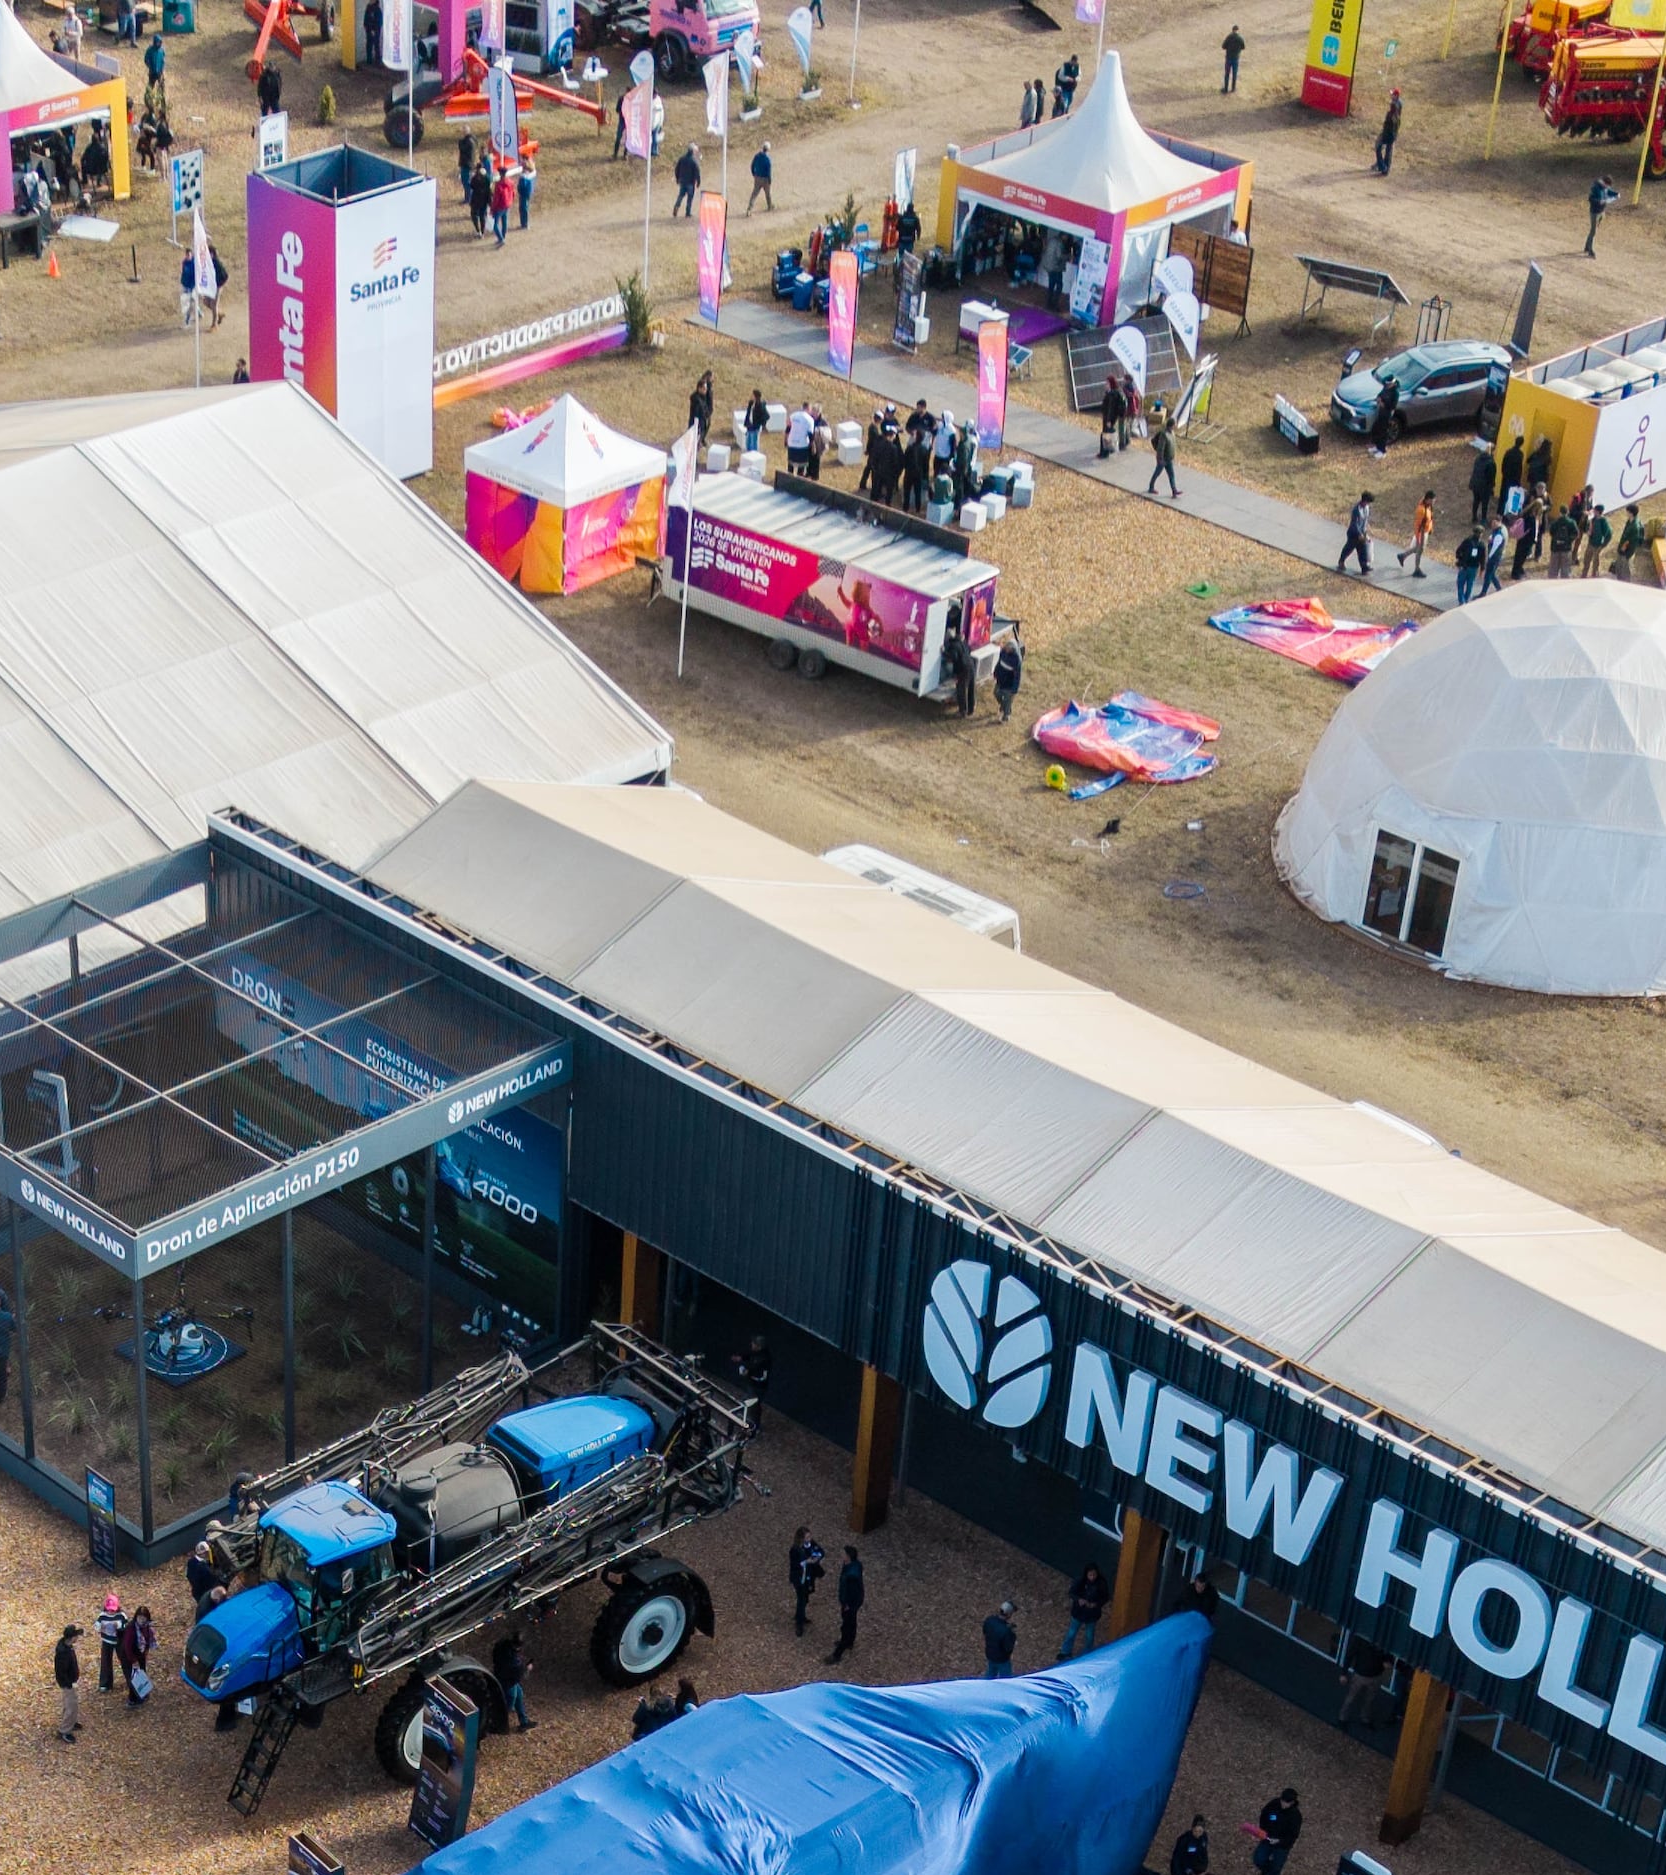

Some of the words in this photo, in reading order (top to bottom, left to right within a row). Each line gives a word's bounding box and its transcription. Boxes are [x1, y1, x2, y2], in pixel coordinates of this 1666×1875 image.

[284, 230, 313, 294] Fe
[350, 276, 395, 304] Santa
[398, 266, 420, 289] Fe
[284, 298, 313, 382] nta
[694, 518, 711, 534] LOS
[713, 524, 797, 566] SURAMERICANOS
[726, 540, 754, 562] VIVEN
[756, 553, 771, 568] EN
[715, 553, 750, 583] Santa
[751, 567, 770, 587] Fe
[231, 966, 283, 1012] DRON
[366, 1038, 431, 1085] ECOSISTEMA
[466, 1088, 498, 1115] NEW
[499, 1058, 563, 1100] HOLLAND
[146, 1228, 193, 1264] Dron
[195, 1217, 218, 1240] de
[219, 1172, 310, 1230] Aplicación
[313, 1146, 360, 1186] P150
[472, 1178, 538, 1223] 4000
[36, 1190, 64, 1220] NEW
[65, 1210, 126, 1260] HOLLAND
[568, 1446, 585, 1459] NEW
[585, 1433, 617, 1454] HOLLAND
[1064, 1341, 1345, 1567] NEW
